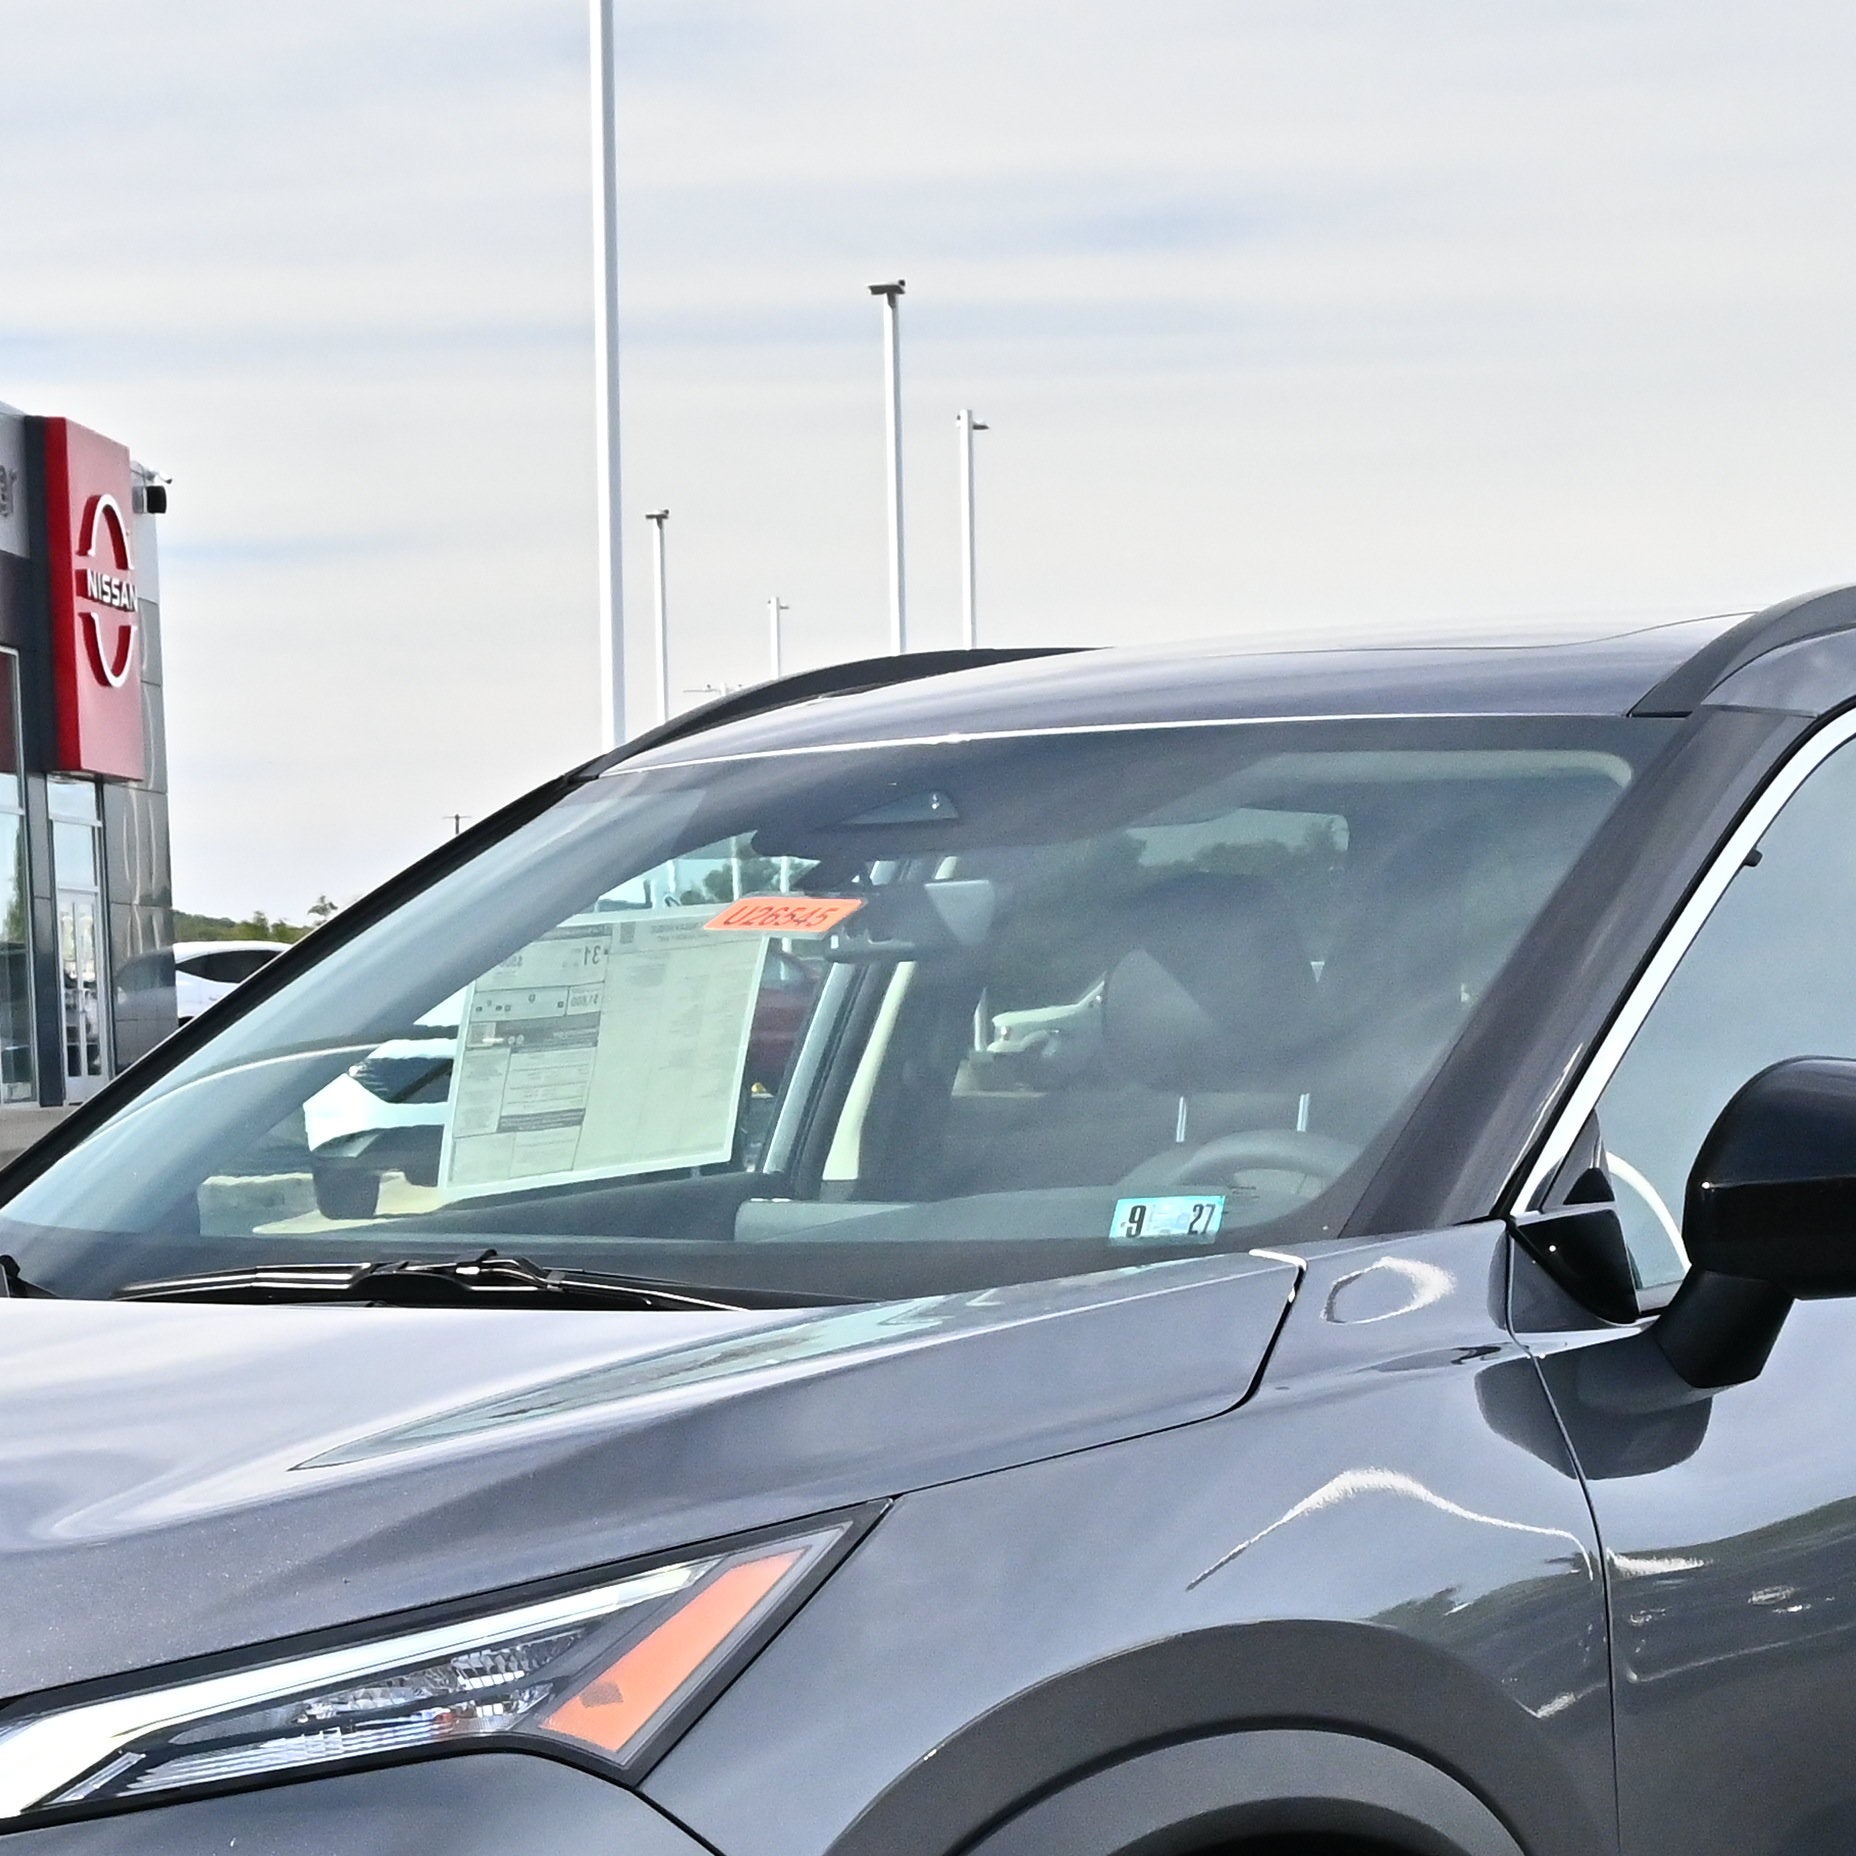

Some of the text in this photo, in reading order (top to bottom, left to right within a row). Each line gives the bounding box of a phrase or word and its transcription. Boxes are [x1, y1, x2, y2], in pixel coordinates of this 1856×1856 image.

[86, 569, 138, 612] NISSAN
[1126, 1203, 1216, 1238] 9 27
